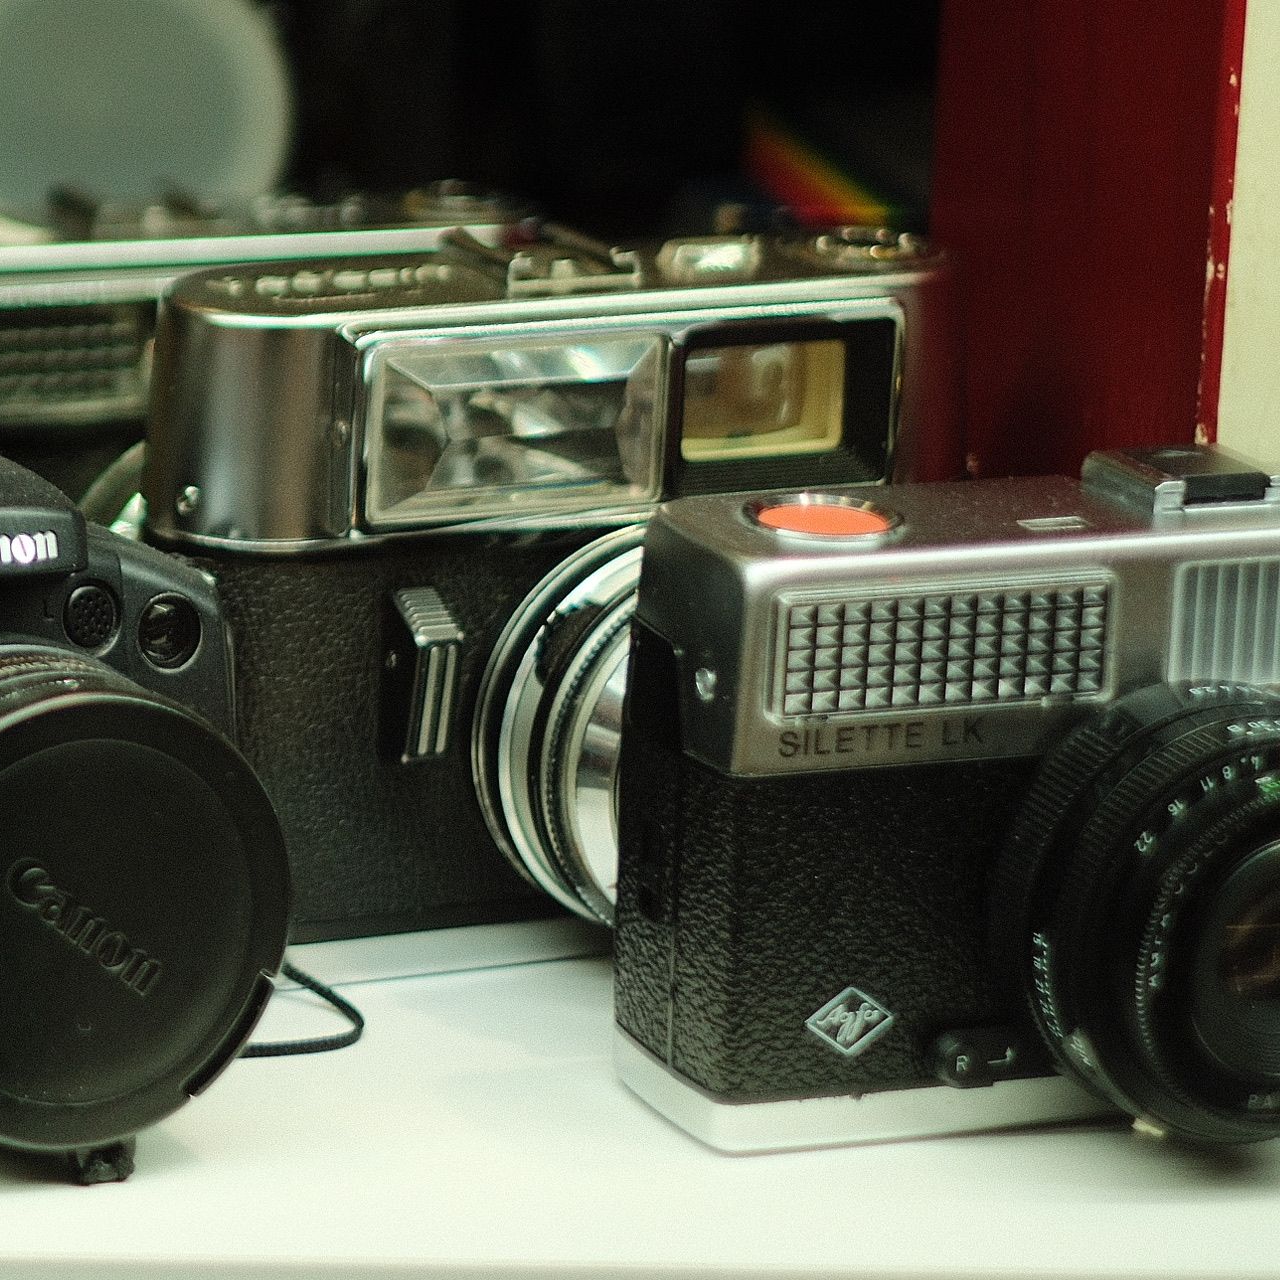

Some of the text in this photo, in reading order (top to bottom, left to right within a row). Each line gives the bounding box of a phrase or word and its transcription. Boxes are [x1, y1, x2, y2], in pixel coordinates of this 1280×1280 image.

[777, 717, 985, 759] SILETTE LK
[1199, 775, 1215, 793] 11
[1222, 765, 1233, 781] 8
[1167, 798, 1186, 818] 16
[1134, 830, 1154, 854] 22
[5, 856, 164, 997] Canon
[815, 1001, 882, 1043] Agfa
[955, 1054, 969, 1072] R
